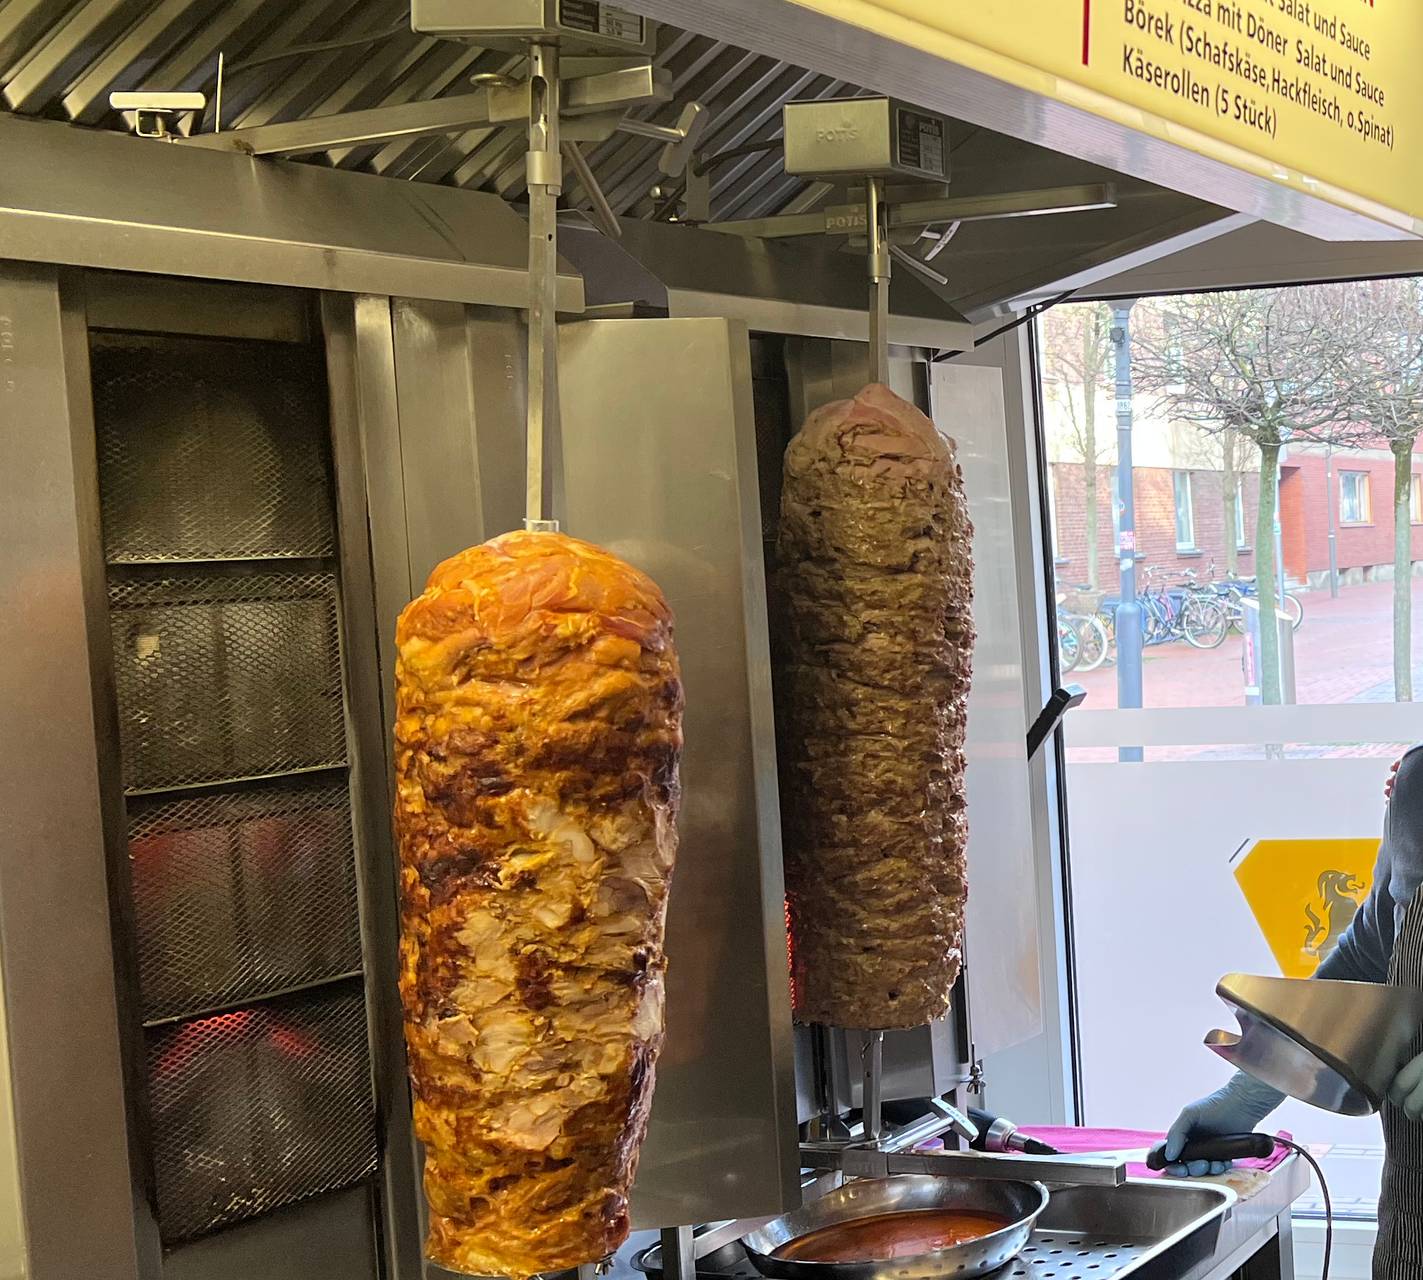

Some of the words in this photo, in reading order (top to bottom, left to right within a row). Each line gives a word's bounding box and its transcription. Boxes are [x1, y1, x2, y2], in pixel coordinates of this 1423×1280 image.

[1124, 0, 1174, 45] Börek
[1217, 2, 1242, 34] mit
[1247, 12, 1288, 56] Döner
[1331, 65, 1352, 90] und
[1355, 72, 1385, 107] Sauce
[1314, 12, 1337, 41] und
[1340, 23, 1370, 60] Sauce
[1123, 44, 1209, 107] Käserollen
[1215, 84, 1229, 117] (5
[1234, 94, 1277, 139] Stück)
